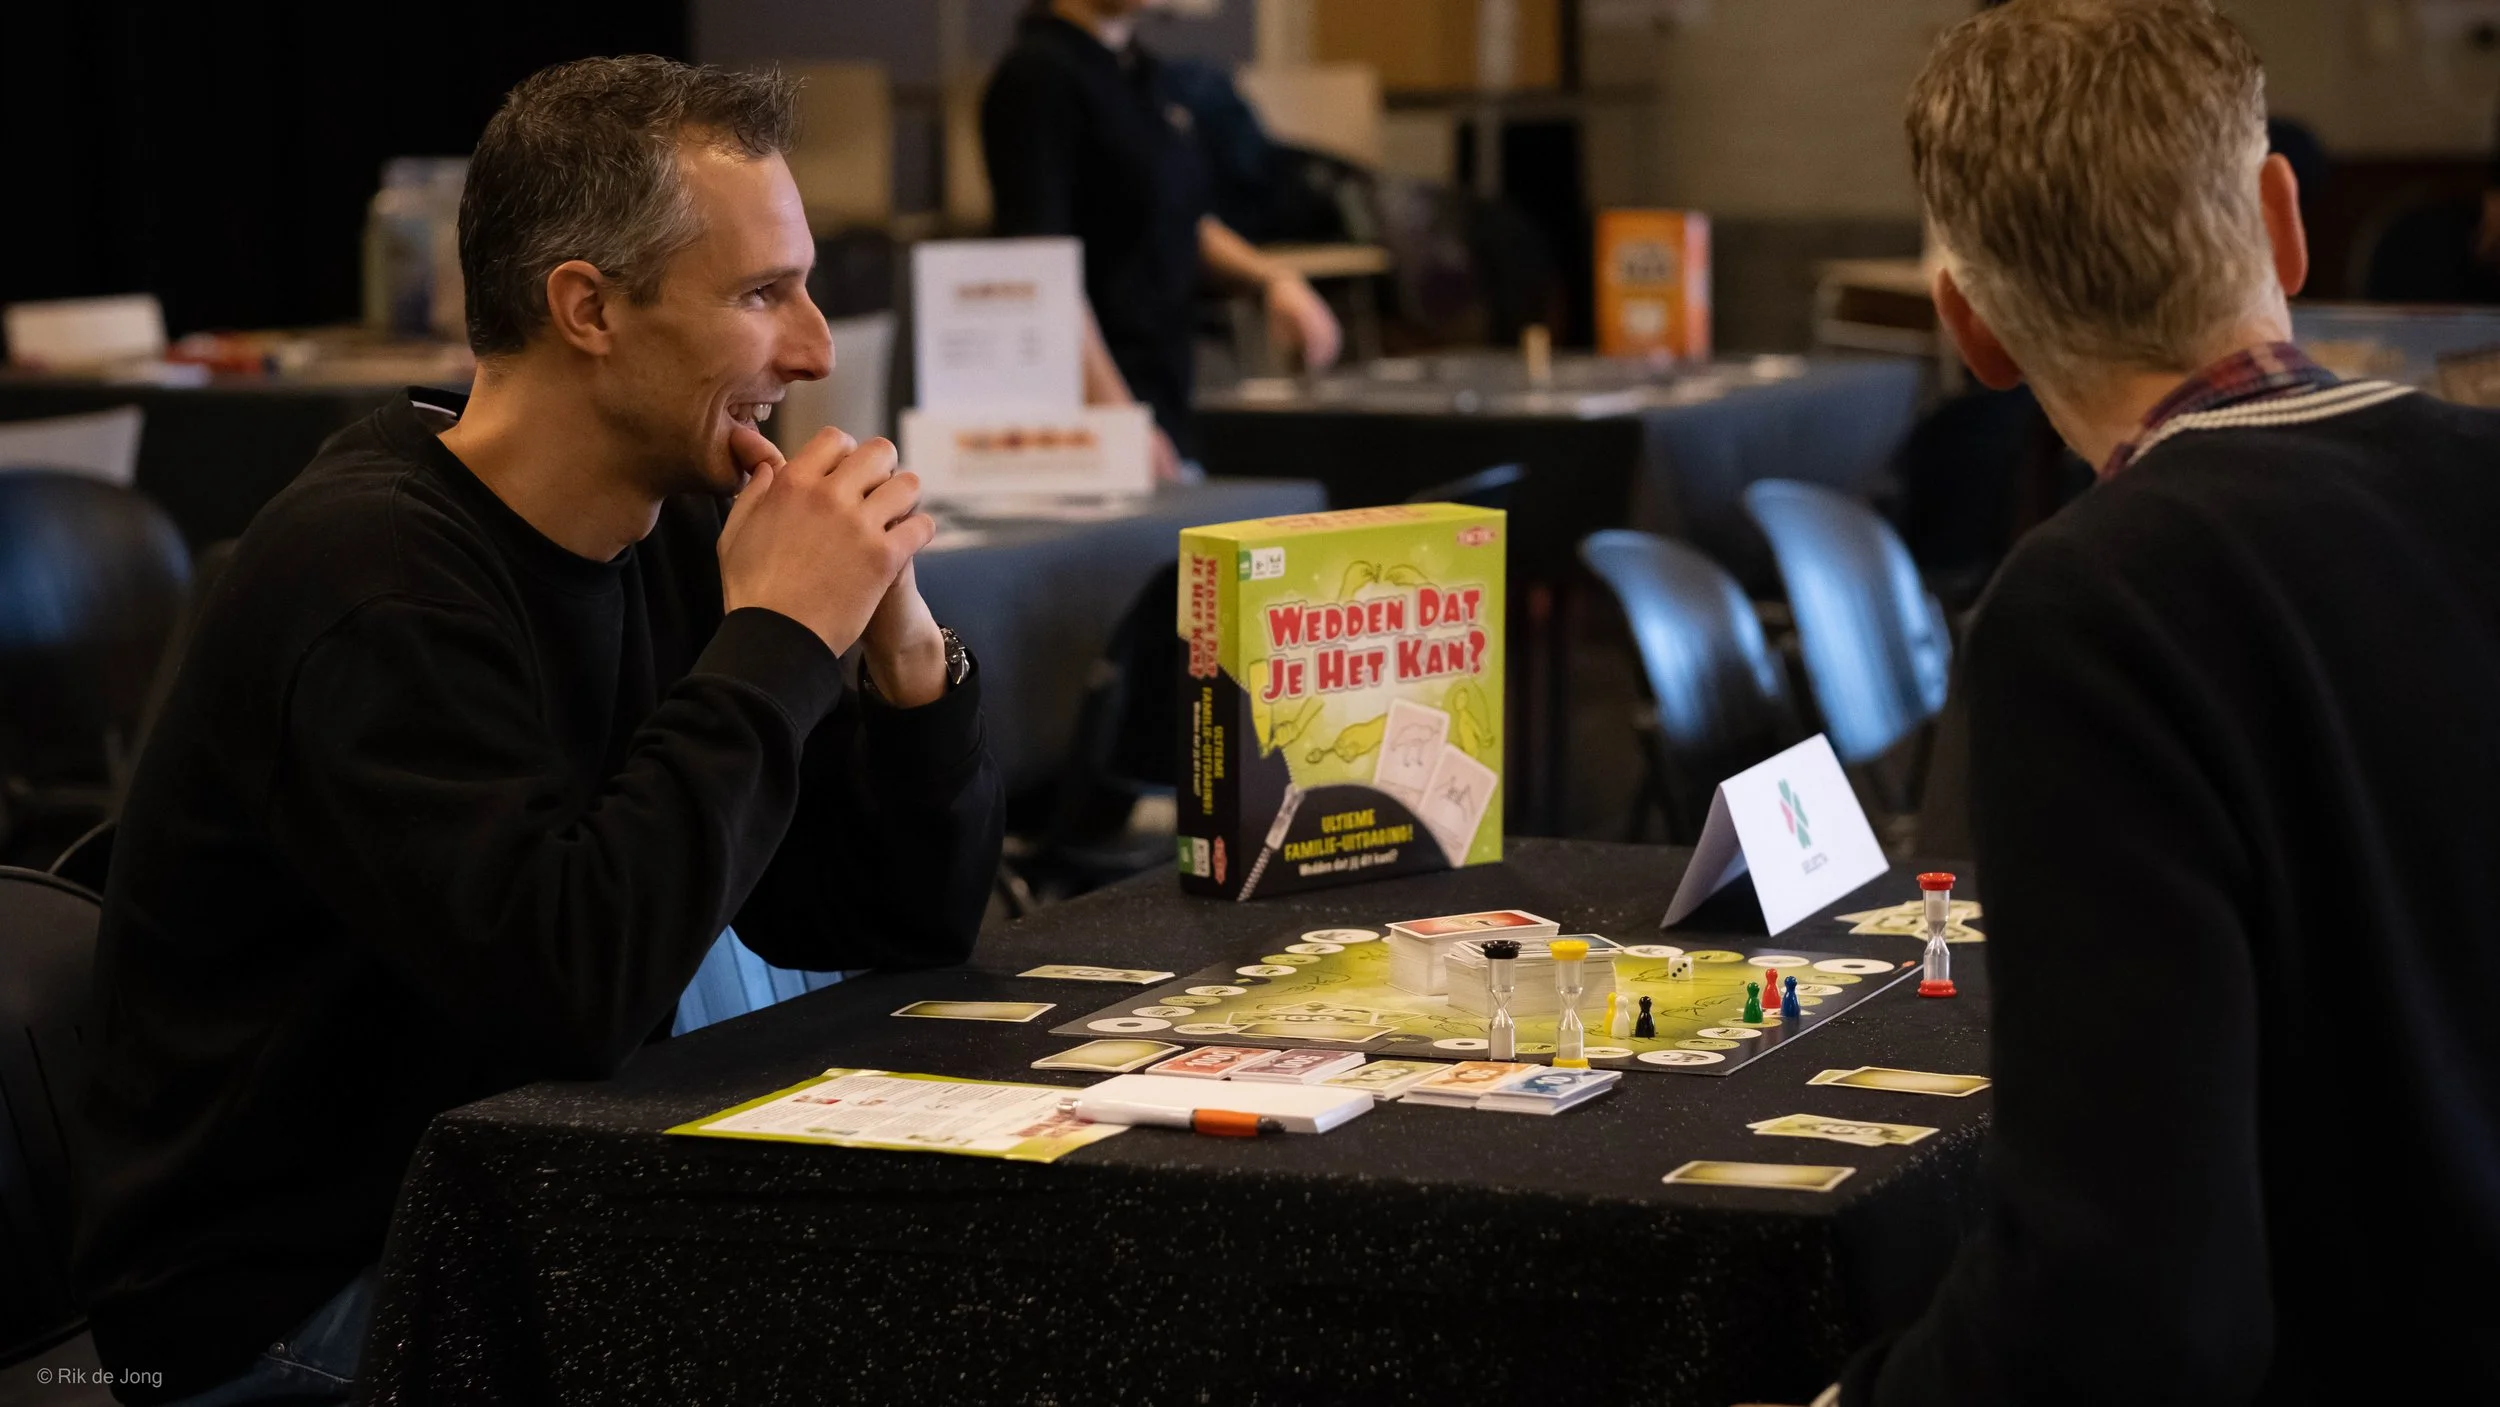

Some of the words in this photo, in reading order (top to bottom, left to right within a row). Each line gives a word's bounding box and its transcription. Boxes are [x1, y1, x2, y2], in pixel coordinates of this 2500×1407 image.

[1207, 559, 1217, 632] WEDDEN
[1268, 600, 1404, 648] WEDDEN
[1416, 587, 1481, 627] DAT
[1263, 658, 1304, 700] JE
[1317, 648, 1385, 692] HET
[1396, 631, 1486, 681] KAN?
[1321, 808, 1376, 833] ULTIEME
[1284, 824, 1413, 861] FAMILIE-UITDAGING!
[1184, 1051, 1241, 1067] 1000
[1818, 1123, 1883, 1135] 100
